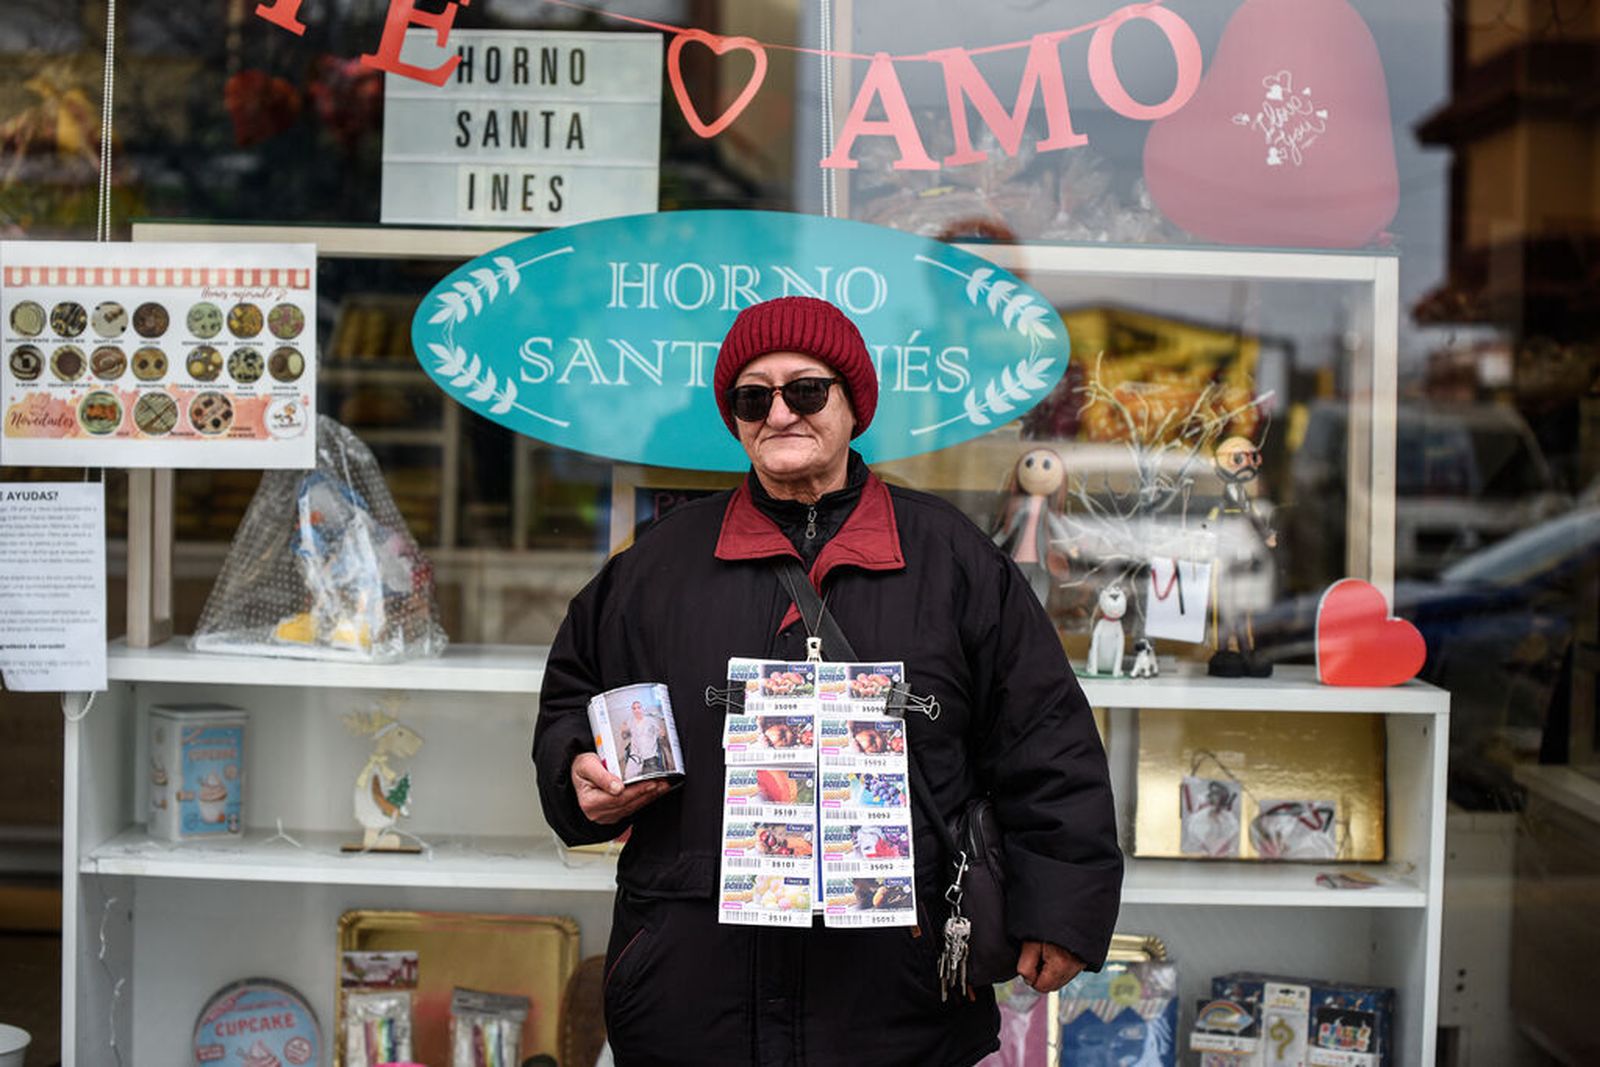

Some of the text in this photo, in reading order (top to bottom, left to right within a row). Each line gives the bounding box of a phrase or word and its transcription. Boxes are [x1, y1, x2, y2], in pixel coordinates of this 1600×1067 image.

[457, 46, 586, 87] HORNO
[820, 3, 1202, 170] AMO
[456, 110, 585, 149] SANTA
[468, 173, 565, 212] INES
[606, 262, 888, 315] HORNO
[519, 337, 718, 388] SANT
[10, 410, 75, 430] Novedades
[7, 490, 59, 501] AYUDAS?
[214, 1011, 297, 1037] CUPCAKE
